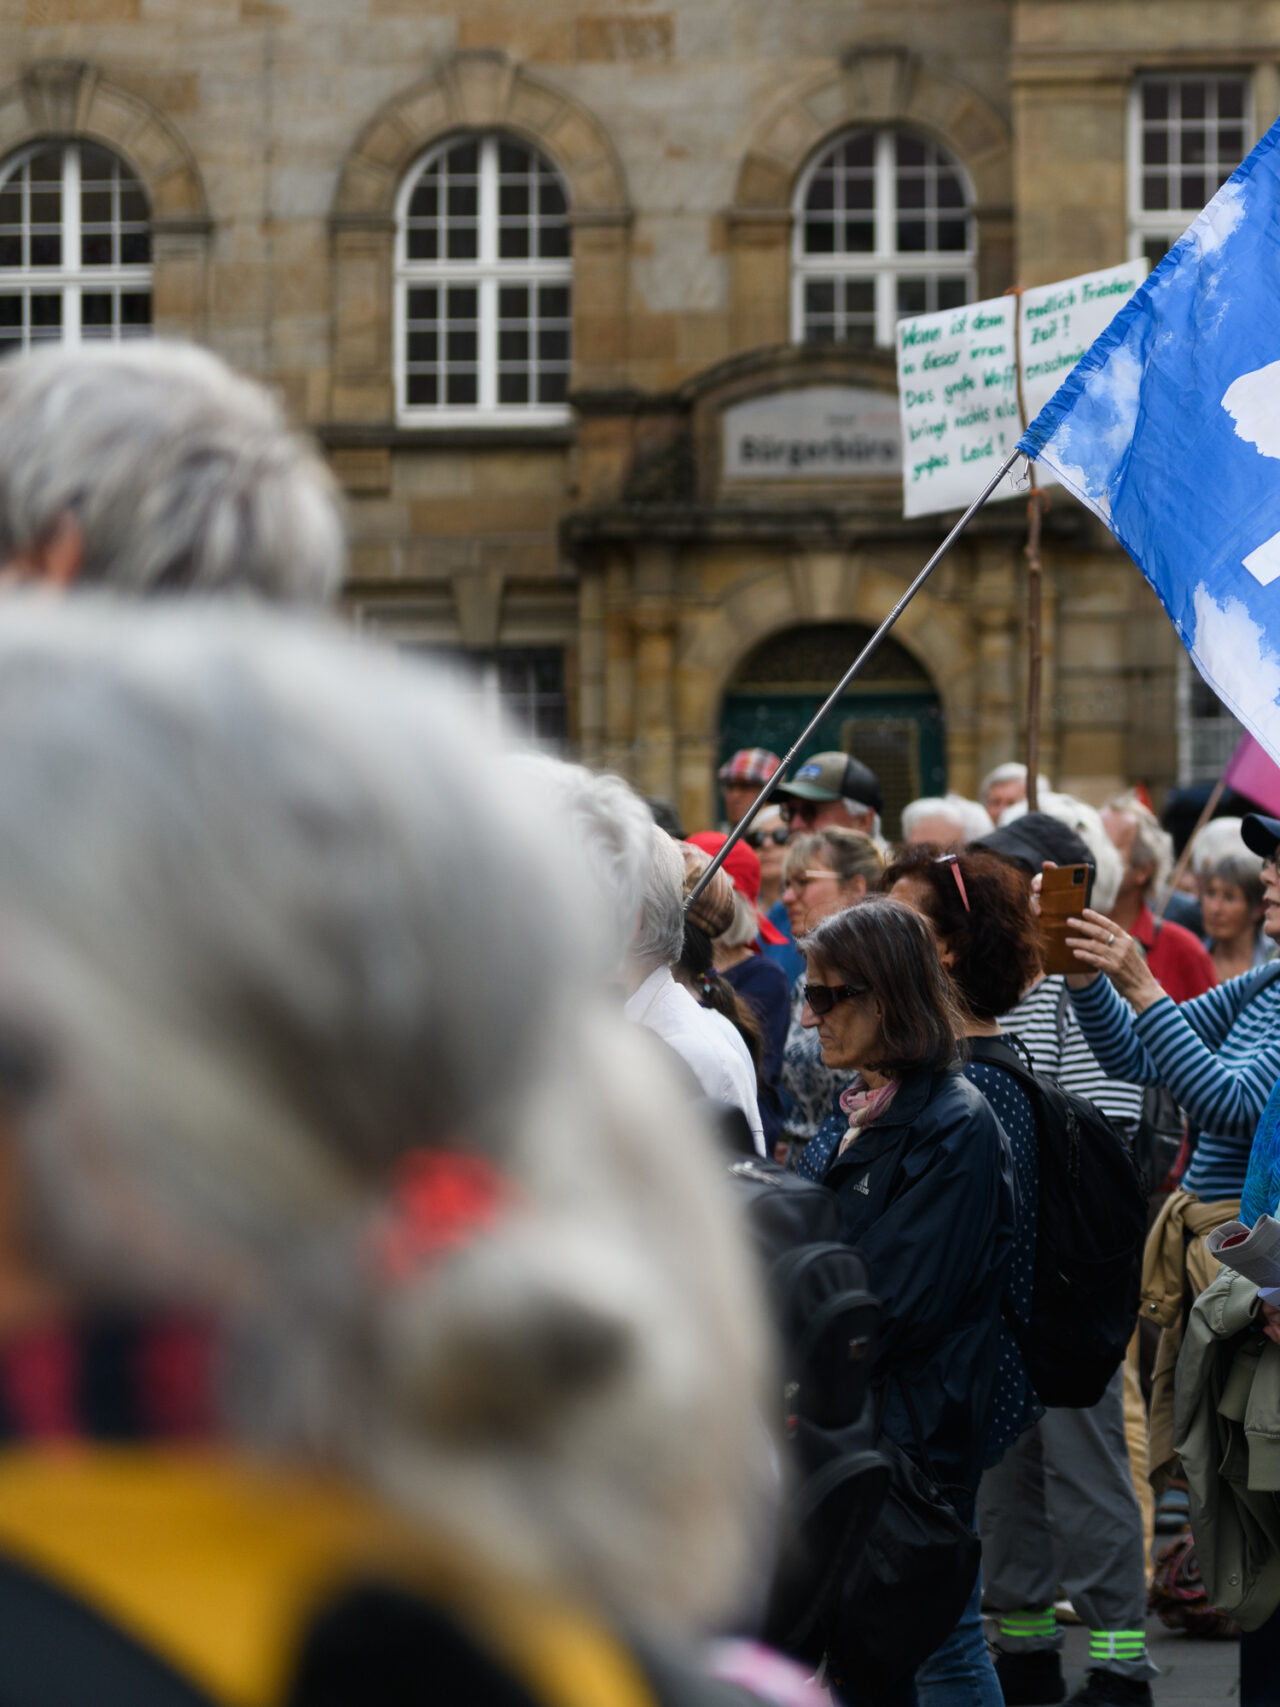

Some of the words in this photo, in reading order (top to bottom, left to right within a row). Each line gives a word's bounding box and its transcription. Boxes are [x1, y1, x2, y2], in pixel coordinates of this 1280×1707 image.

[901, 321, 941, 350] Wann
[950, 312, 968, 336] ist
[971, 311, 1005, 331] denn
[1026, 288, 1076, 321] endlich
[1082, 278, 1136, 303] Frieden
[922, 349, 960, 371] dieser
[970, 339, 1005, 359] irren
[905, 388, 935, 410] Das
[909, 414, 948, 442] bringt
[955, 403, 989, 428] nichts
[961, 435, 994, 463] Leid
